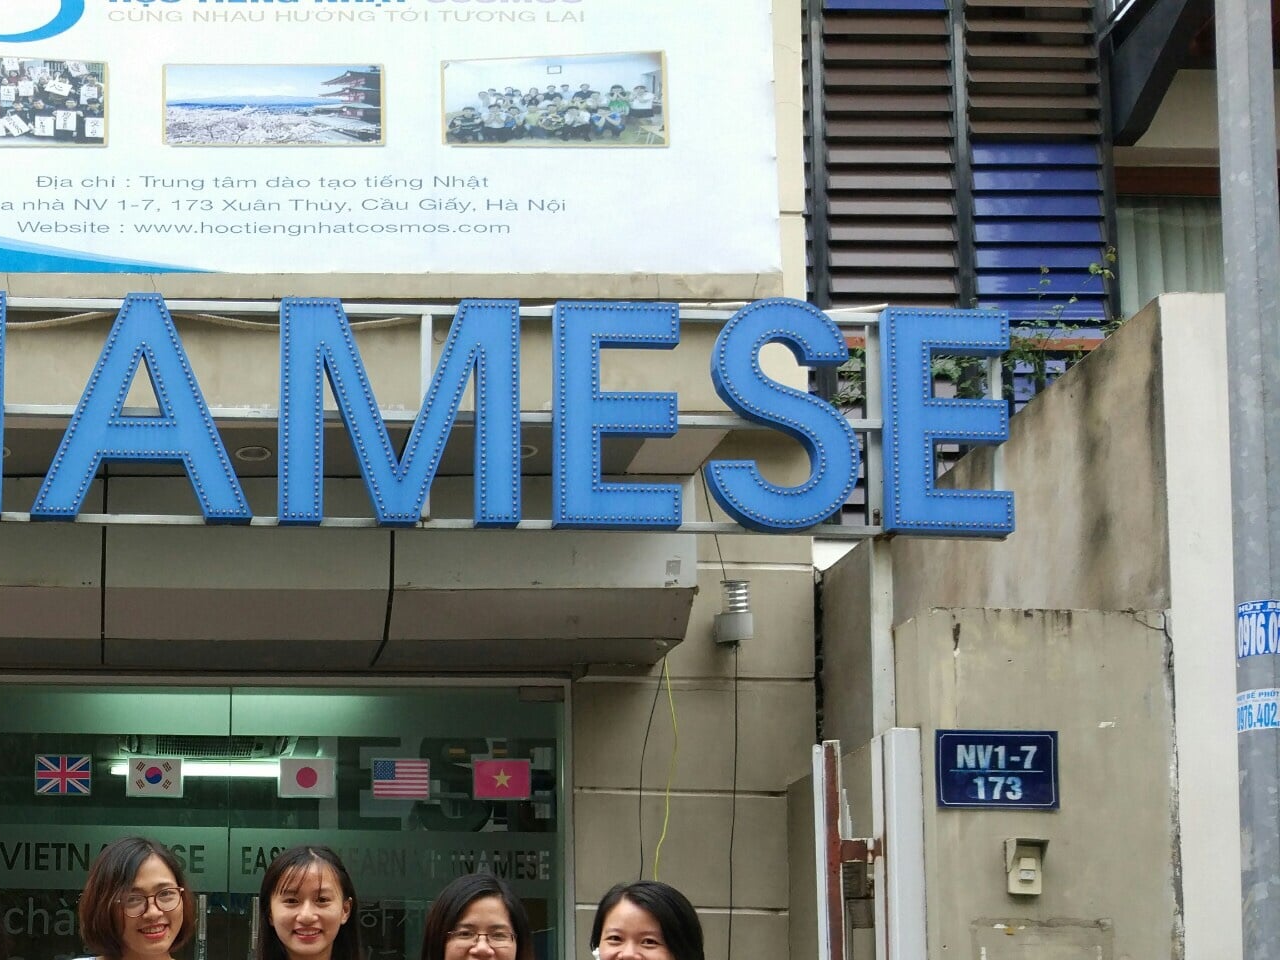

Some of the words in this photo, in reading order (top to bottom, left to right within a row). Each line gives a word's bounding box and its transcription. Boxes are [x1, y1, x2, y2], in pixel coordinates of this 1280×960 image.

[192, 9, 265, 22] NHAU
[546, 10, 585, 22] LAI
[36, 175, 73, 190] Địa
[139, 175, 205, 191] Trung
[213, 175, 257, 188] tâm
[319, 176, 357, 190] tạo
[364, 174, 423, 191] tiếng
[433, 175, 489, 190] Nhật
[22, 198, 65, 211] nhà
[74, 199, 108, 211] NV
[117, 199, 161, 213] 1-7,
[171, 199, 214, 211] 173
[222, 199, 280, 212] Xuân
[486, 198, 518, 212] Hà
[528, 199, 566, 214] Nội
[17, 220, 111, 234] Website
[133, 221, 511, 237] www.hoctiengnhatcosmos.com
[1238, 612, 1280, 658] 0916.0
[955, 744, 1038, 770] NV1-7
[972, 776, 1023, 801] 173
[0, 841, 205, 874] VIETNSE
